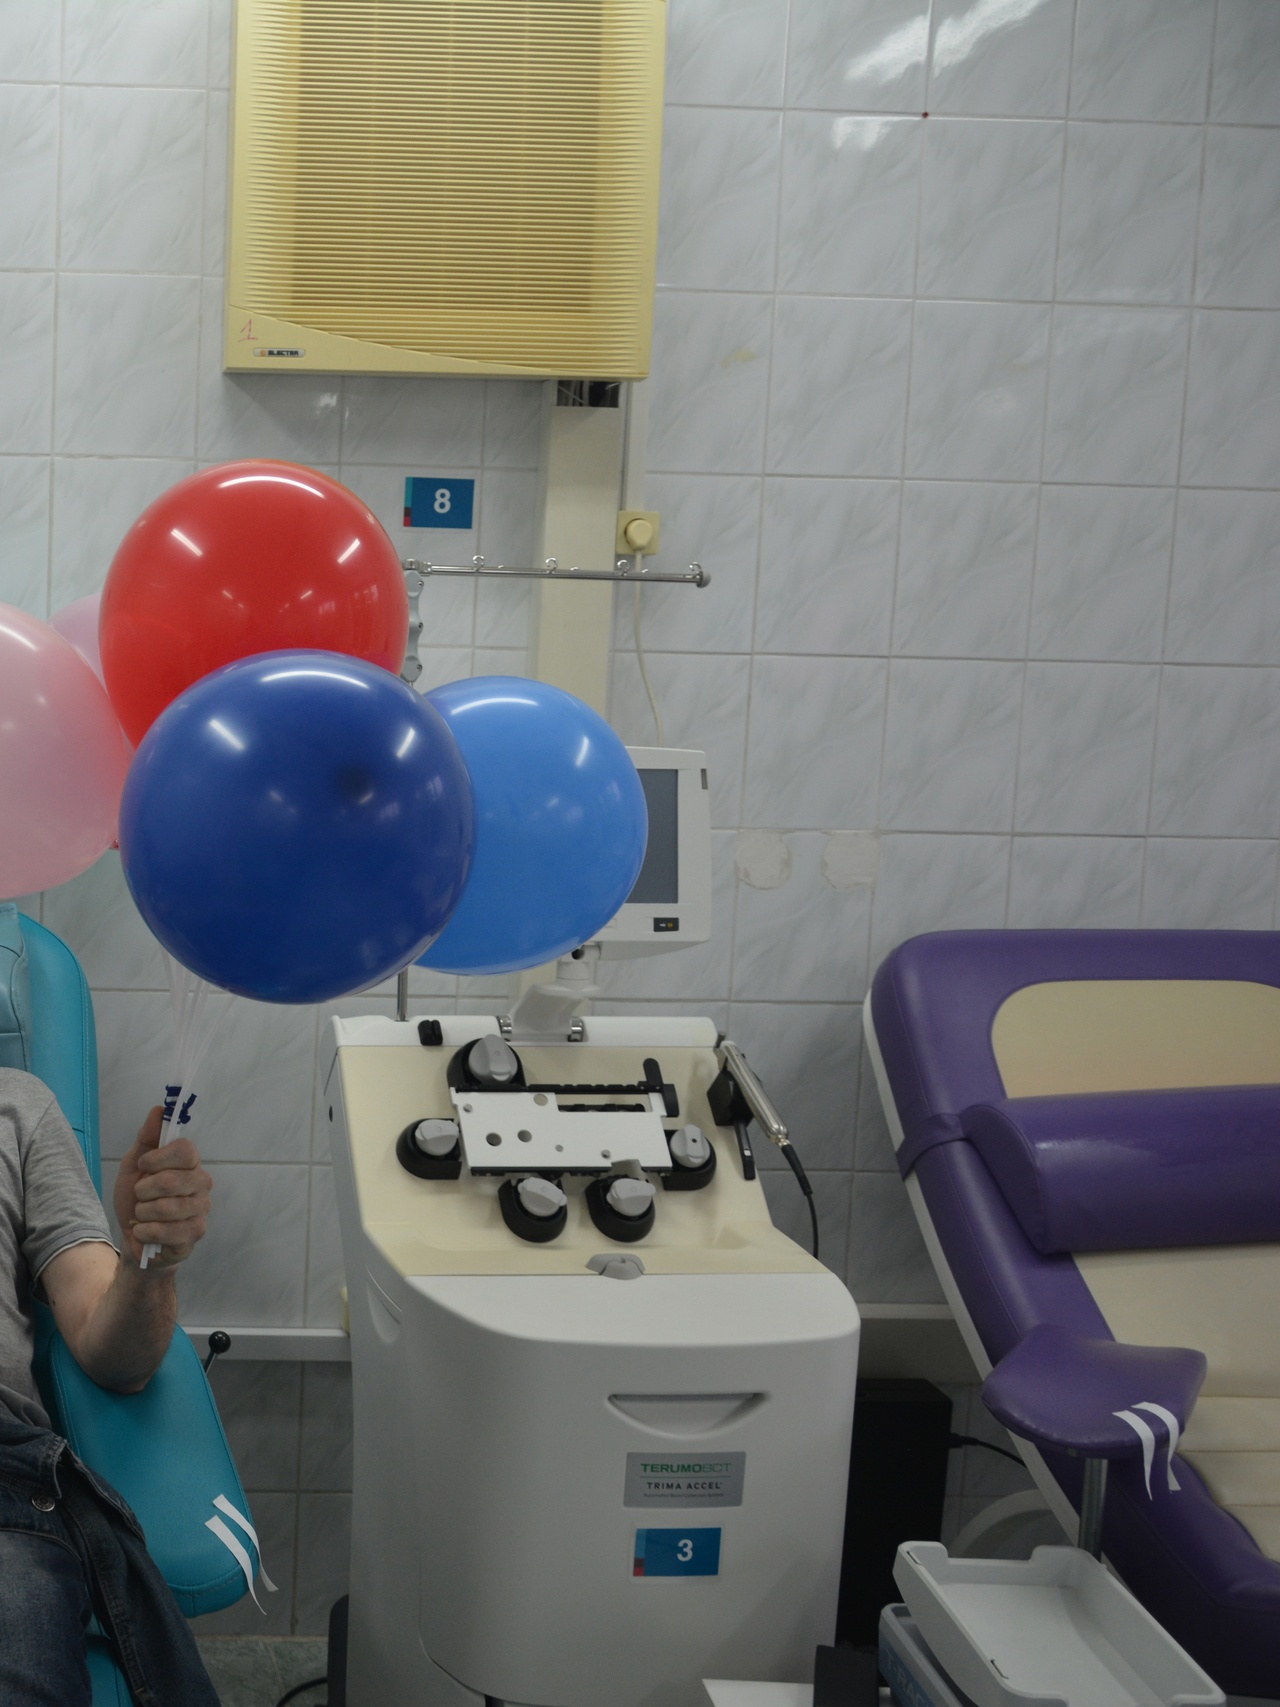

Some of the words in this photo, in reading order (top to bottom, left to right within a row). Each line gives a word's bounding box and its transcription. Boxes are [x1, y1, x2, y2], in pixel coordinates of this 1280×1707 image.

[433, 488, 451, 514] 8
[640, 1462, 732, 1473] TERUMOBCT
[646, 1482, 682, 1490] TRIMA
[686, 1481, 721, 1490] ACCEL
[676, 1538, 694, 1562] 3
